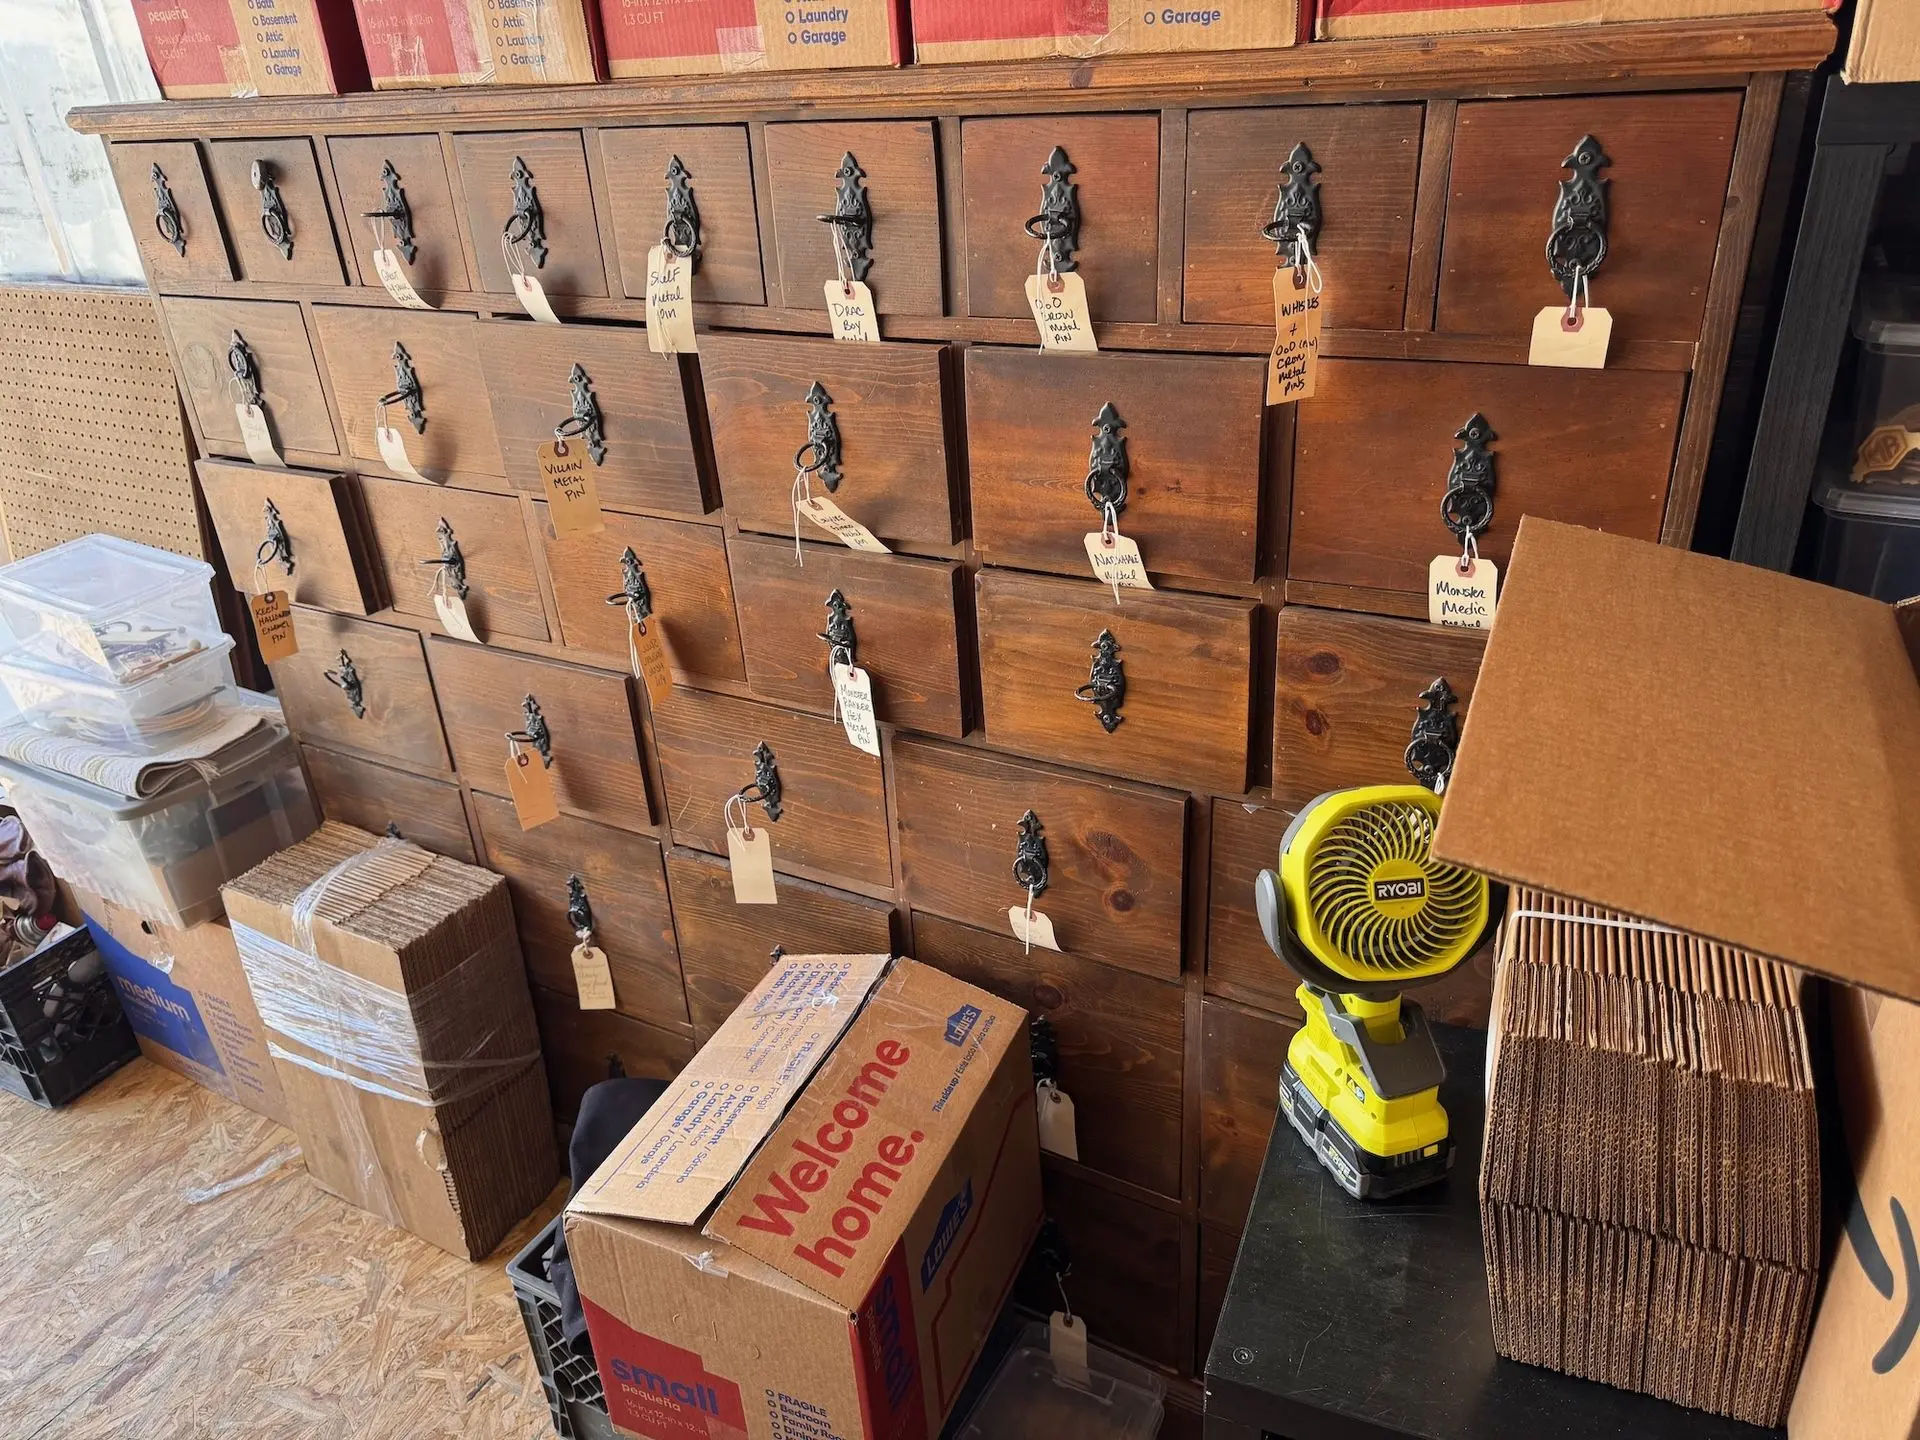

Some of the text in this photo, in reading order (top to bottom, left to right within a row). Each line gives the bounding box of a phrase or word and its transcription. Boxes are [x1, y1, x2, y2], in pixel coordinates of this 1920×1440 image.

[260, 13, 298, 26] Basement
[503, 14, 525, 28] Attic
[623, 11, 664, 25] 1.3 CU FT
[799, 7, 848, 23] Laundry
[1162, 9, 1221, 26] Garage
[266, 30, 284, 42] Attic
[801, 29, 847, 46] Garage
[269, 46, 300, 58] Laundry
[511, 53, 546, 66] Garage
[274, 63, 302, 76] Garage
[544, 458, 582, 475] VILLAIN
[553, 475, 585, 489] METAL
[565, 484, 586, 502] PIN
[1442, 600, 1488, 617] Medic
[1377, 882, 1421, 898] RYOBI
[772, 970, 794, 989] Bath
[777, 971, 808, 1000] Kitchen
[116, 975, 191, 1021] medium
[672, 1091, 708, 1128] Garage
[683, 1092, 724, 1133] Laundry
[713, 1094, 737, 1118] Attic
[708, 1095, 754, 1145] Basement
[736, 1039, 911, 1237] Welcome
[640, 1135, 671, 1165] Garaje
[793, 1130, 925, 1279] home.
[610, 1358, 719, 1416] small
[621, 1383, 681, 1412] pequeña
[778, 1393, 827, 1418] FRAGILE
[780, 1403, 832, 1429] Bedroom
[782, 1414, 819, 1435] Family
